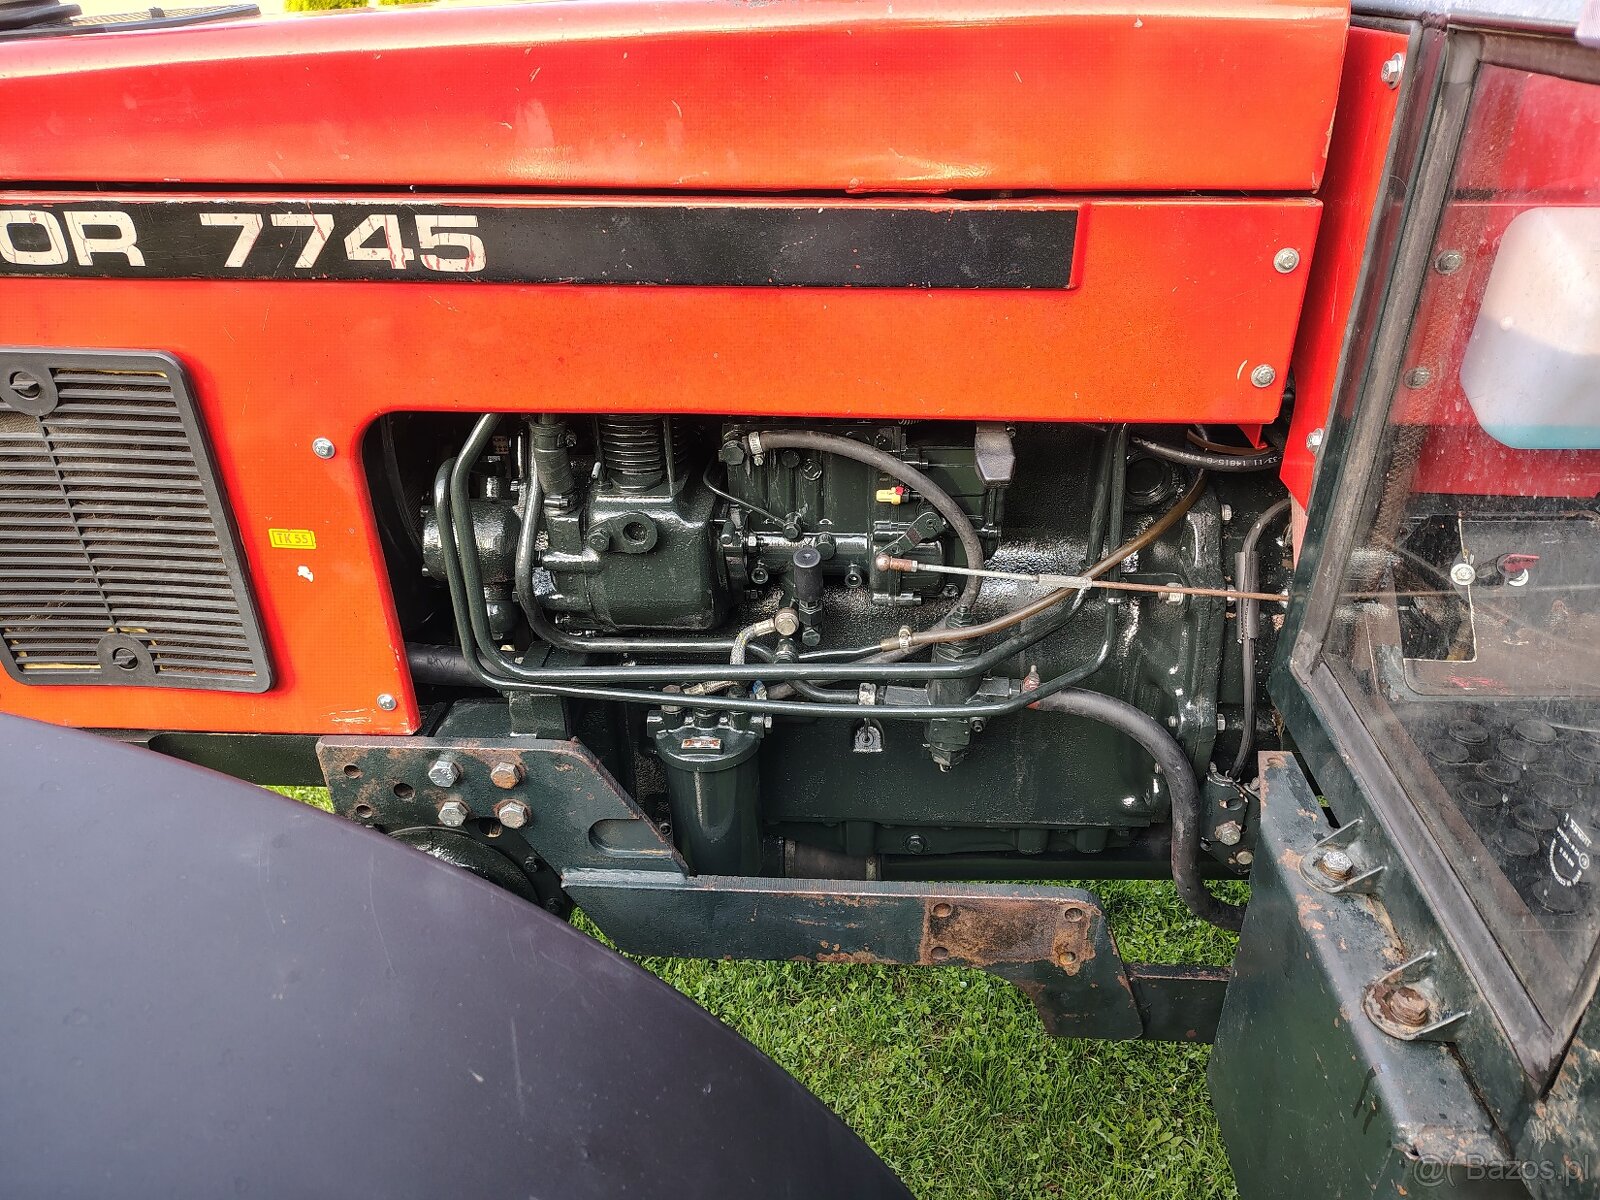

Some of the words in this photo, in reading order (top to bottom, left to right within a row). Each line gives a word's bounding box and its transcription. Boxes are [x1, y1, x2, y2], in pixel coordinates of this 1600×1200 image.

[0, 210, 146, 267] OR
[199, 213, 487, 272] 7745
[276, 532, 292, 544] TK
